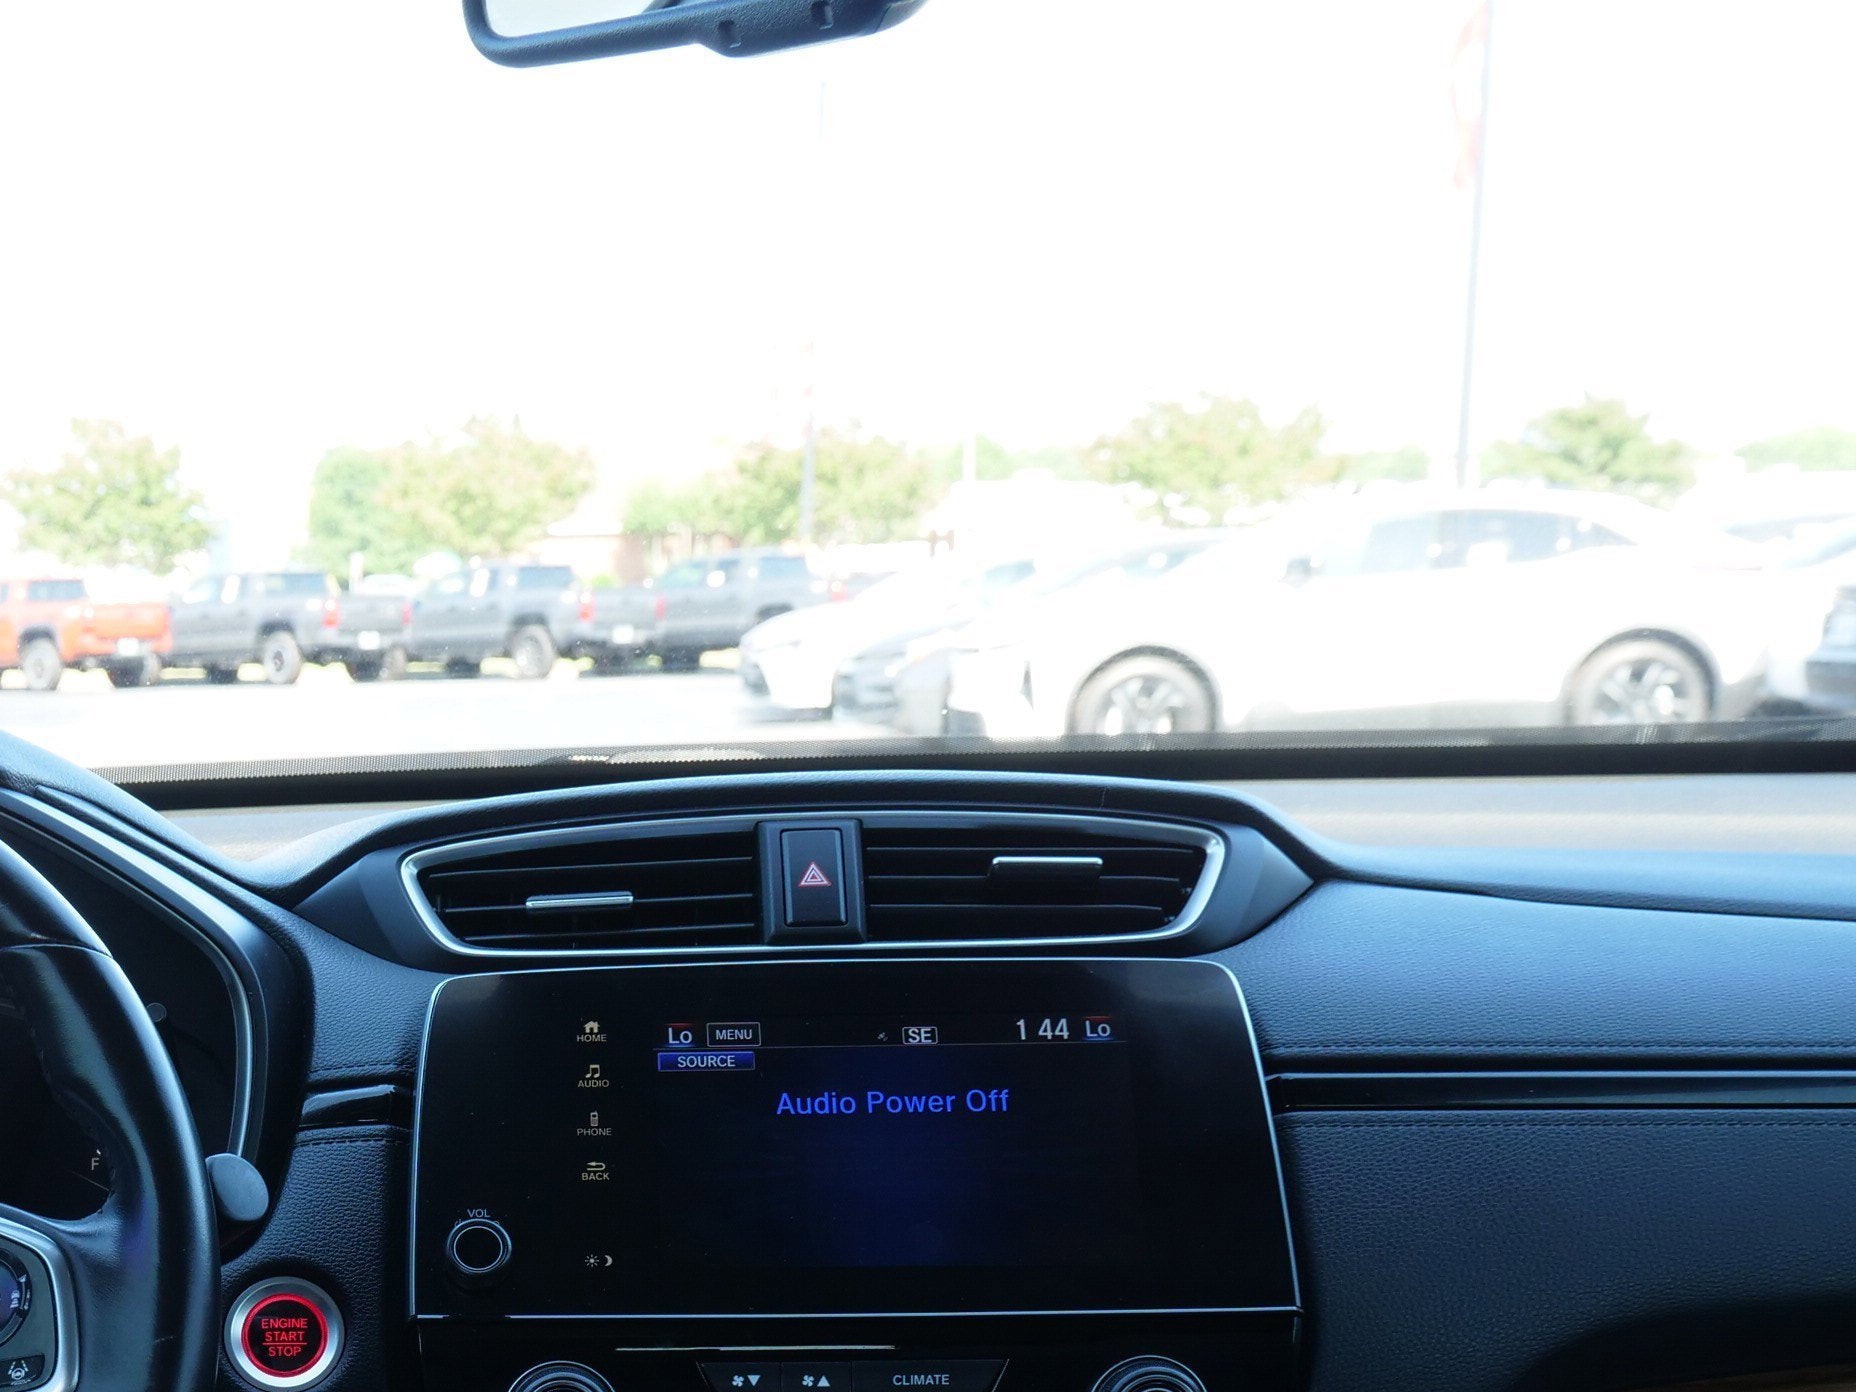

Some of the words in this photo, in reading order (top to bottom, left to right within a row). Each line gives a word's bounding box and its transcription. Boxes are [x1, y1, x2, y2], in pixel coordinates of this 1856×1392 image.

[576, 1033, 607, 1042] HOME
[667, 1026, 693, 1045] Lo
[714, 1027, 753, 1041] MENU
[1084, 1020, 1111, 1037] Lo
[676, 1055, 736, 1069] SOURCE
[576, 1078, 610, 1088] AUDIO
[776, 1090, 857, 1116] Audio
[867, 1089, 956, 1114] Power
[965, 1087, 1010, 1113] Off
[576, 1126, 612, 1137] PHONE
[91, 1157, 100, 1171] F
[581, 1171, 610, 1182] BACK
[467, 1208, 491, 1218] VOL
[261, 1318, 308, 1329] ENGINE
[264, 1331, 305, 1342] START
[268, 1346, 302, 1358] STOP
[892, 1373, 950, 1387] CLIMATE
